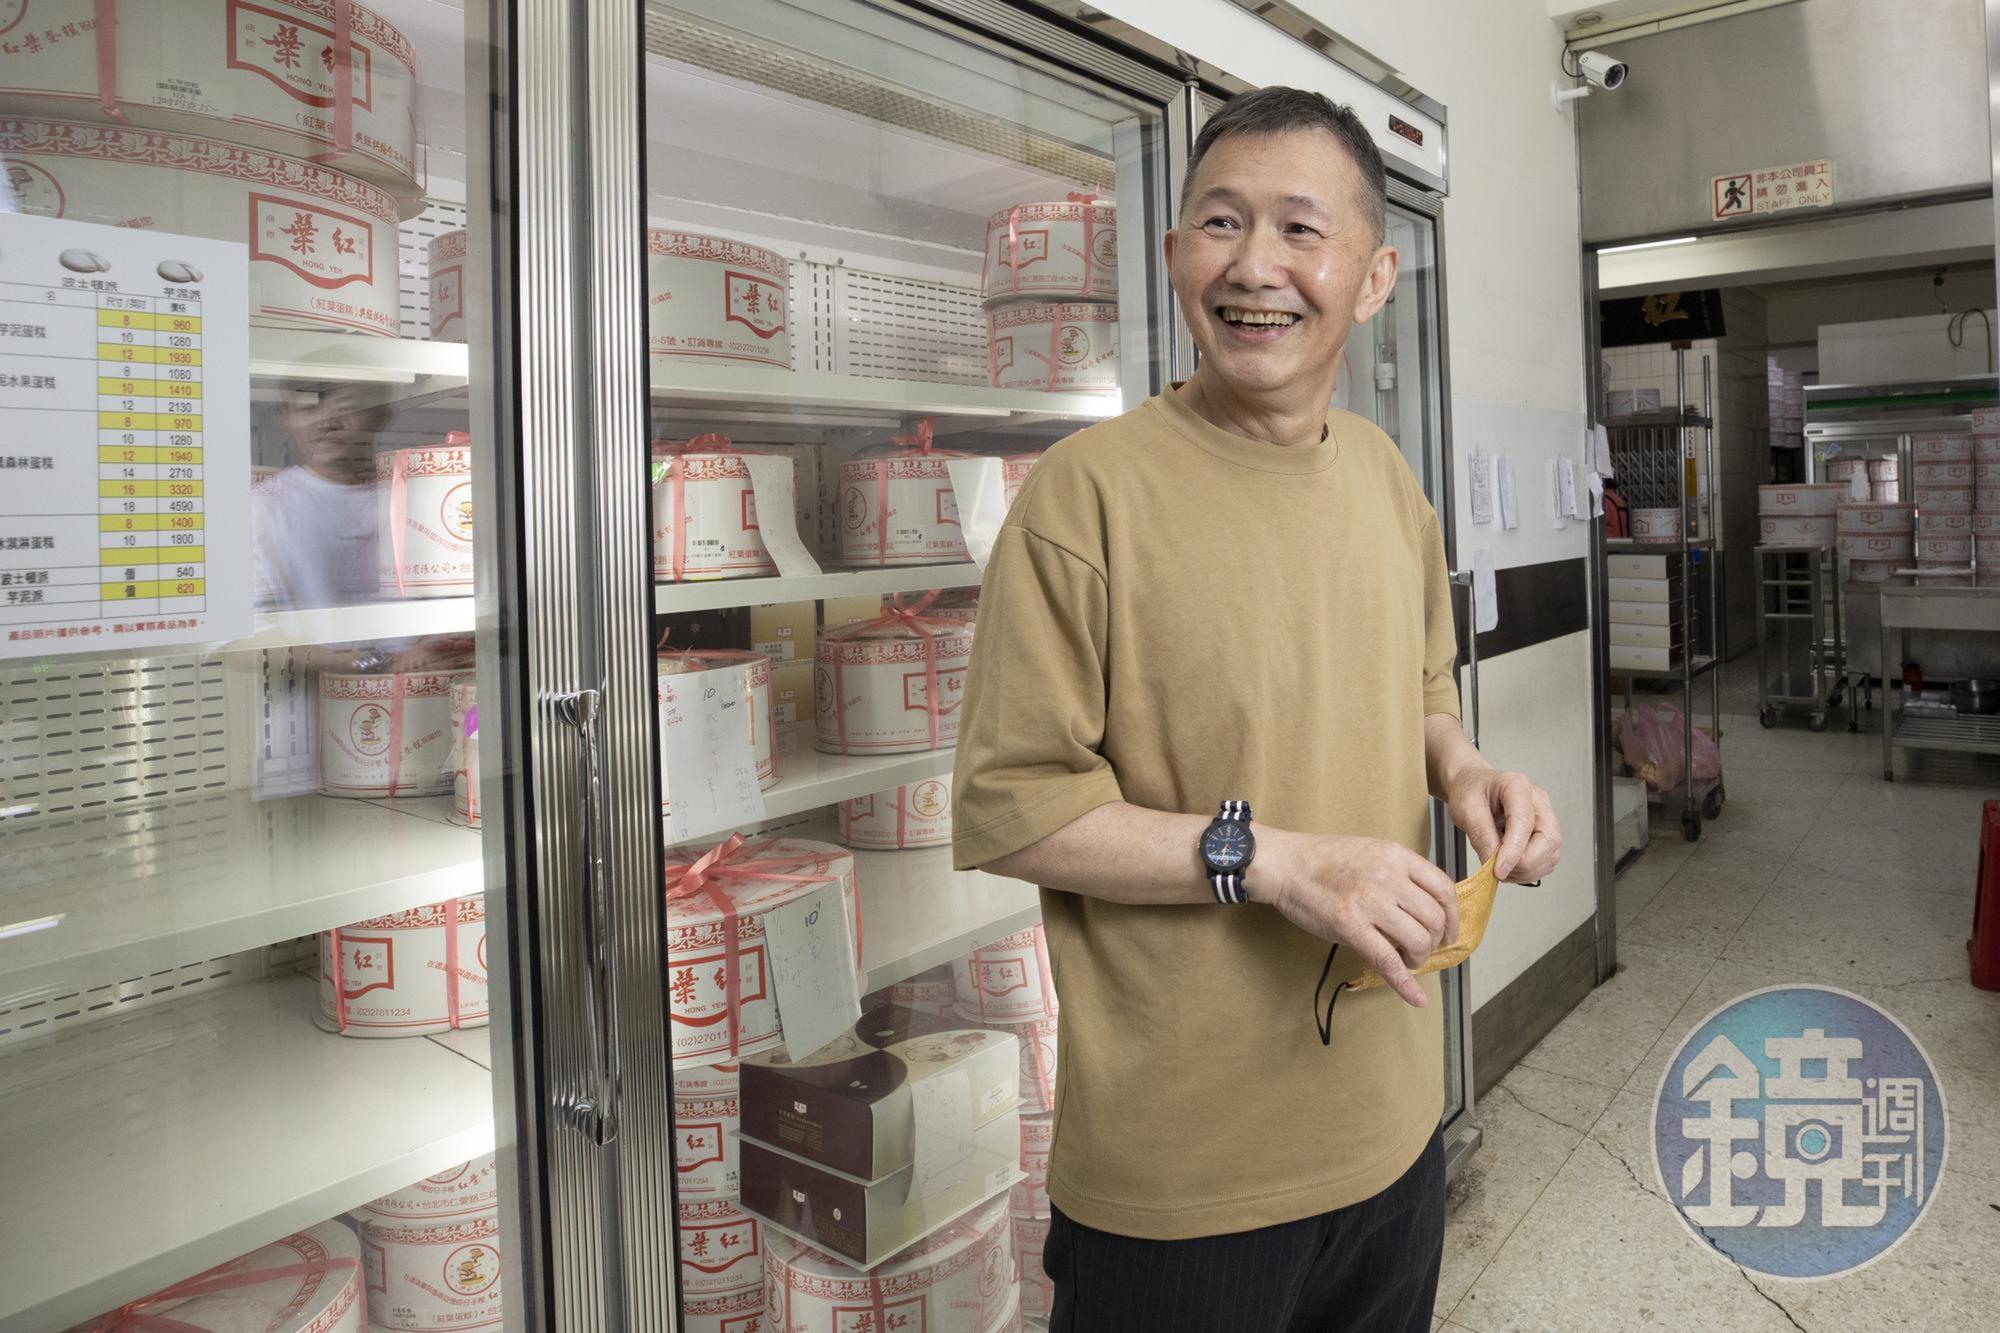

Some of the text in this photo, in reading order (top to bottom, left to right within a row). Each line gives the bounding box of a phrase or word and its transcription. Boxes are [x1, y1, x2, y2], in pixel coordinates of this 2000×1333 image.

[286, 73, 312, 87] HONG
[1756, 163, 1829, 183] 非本公司員工
[1756, 178, 1829, 198] 請勿進入
[1757, 193, 1830, 211] STAFF ONLY
[302, 259, 343, 275] HONG YEH
[62, 277, 119, 292] 波士頓派
[163, 287, 201, 300] 芋泥派
[123, 316, 191, 331] 8 960
[121, 333, 133, 343] 10
[168, 336, 191, 347] 1280
[121, 350, 192, 363] 12 1930
[123, 366, 192, 380] 8 1080
[122, 383, 134, 393] 10
[169, 385, 192, 396] 1410
[122, 400, 192, 413] 12 2130
[123, 417, 192, 429] 8 970
[122, 434, 192, 446] 10 1280
[122, 451, 134, 461] 12
[169, 451, 192, 462] 1940
[123, 467, 193, 478] 14 2710
[123, 484, 193, 495] 16 3320
[123, 501, 193, 512] 18 4590
[125, 517, 193, 529] 8 1400
[123, 535, 136, 545] 10
[170, 533, 194, 545] 1800
[1, 570, 49, 586] 波士頓派
[176, 567, 195, 577] 540
[7, 589, 44, 604] 芋泥派
[176, 583, 195, 594] 620
[684, 1001, 726, 1015] HONG YEH
